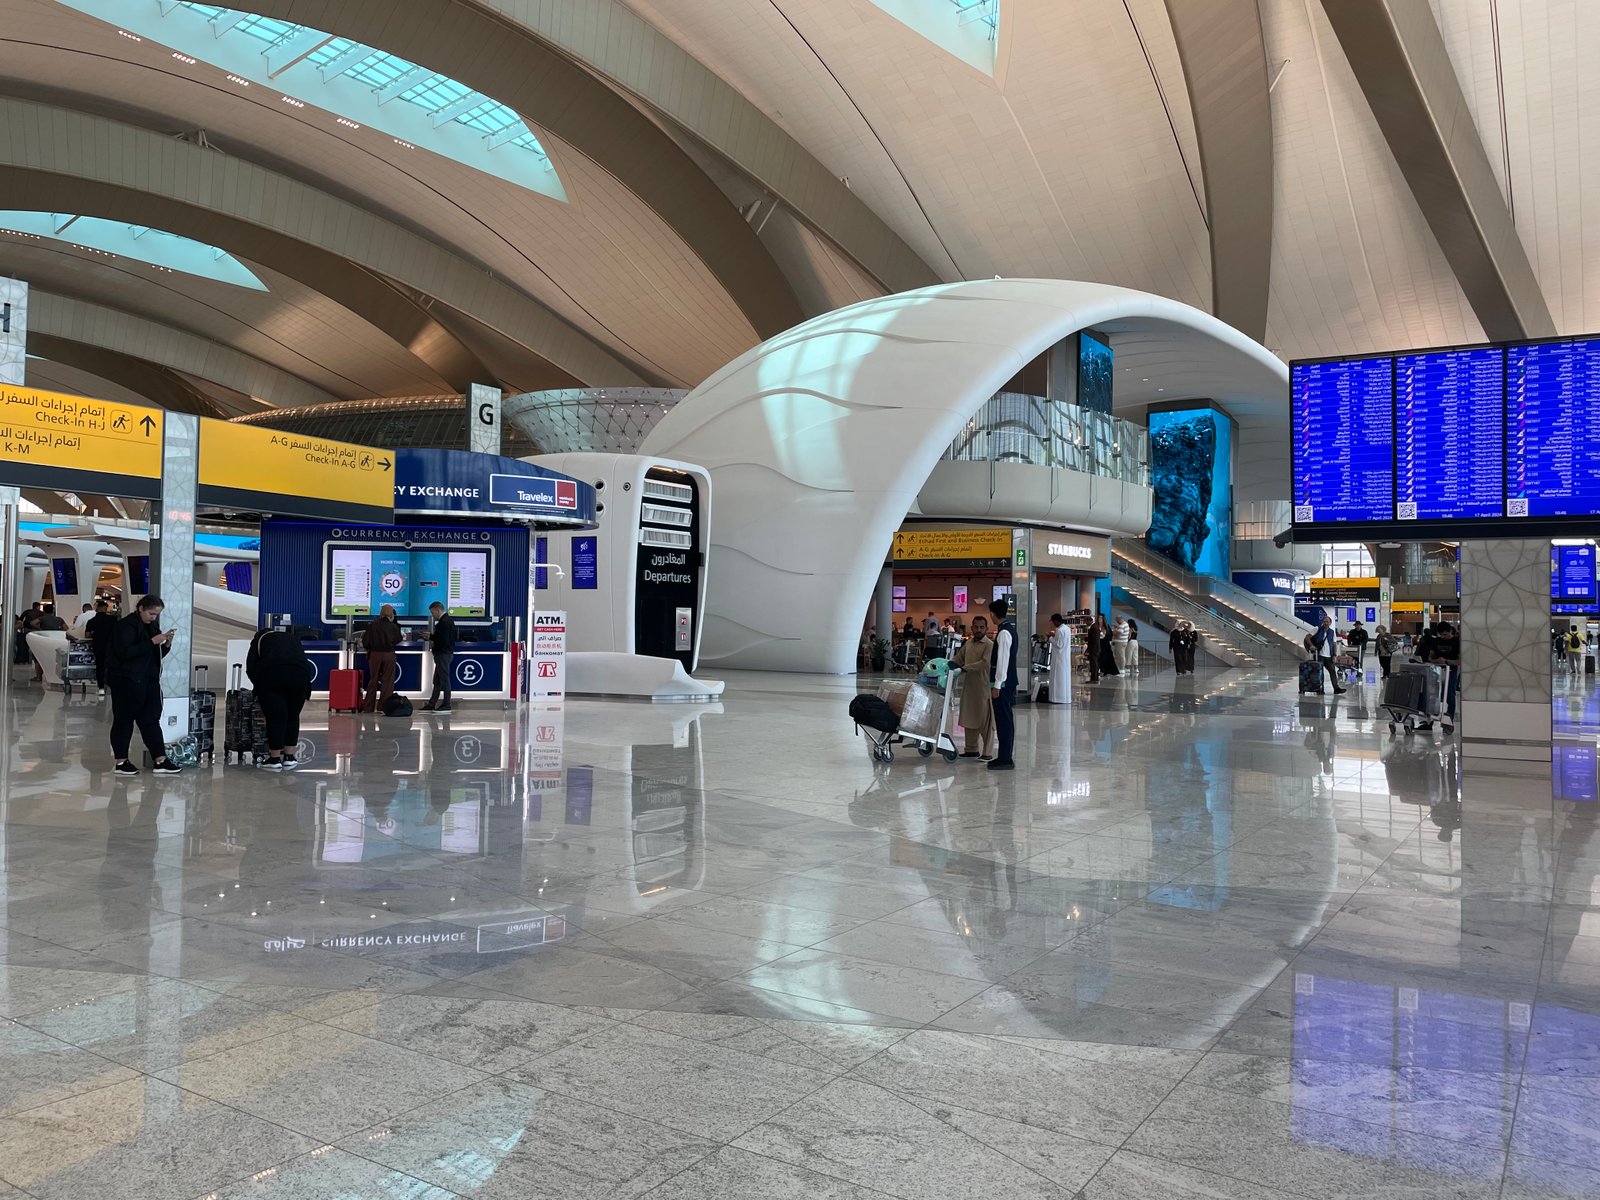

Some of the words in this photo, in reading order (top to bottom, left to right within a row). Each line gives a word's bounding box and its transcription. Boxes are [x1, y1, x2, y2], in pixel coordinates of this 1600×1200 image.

[6, 393, 38, 407] السفر
[41, 399, 77, 414] إجراءات
[80, 407, 105, 418] إتمام
[479, 403, 493, 425] G
[35, 411, 84, 428] Check-In
[89, 419, 105, 430] H-J
[15, 430, 52, 446] إجراءات
[55, 437, 80, 450] إتمام
[270, 435, 288, 446] A-G
[5, 442, 30, 454] K-M
[290, 440, 311, 450] السفر
[313, 445, 338, 457] إجراءات
[340, 450, 356, 458] إتمام
[305, 453, 339, 465] Check-In
[341, 460, 356, 469] A-G
[410, 486, 479, 498] EXCHANGE
[517, 491, 553, 503] Travelex
[343, 529, 406, 538] CURRENCY
[414, 531, 476, 540] EXCHANGE
[1048, 543, 1091, 558] STARBUCKS
[652, 553, 685, 566] المغادرون
[645, 570, 691, 584] Departures
[385, 579, 400, 588] 50
